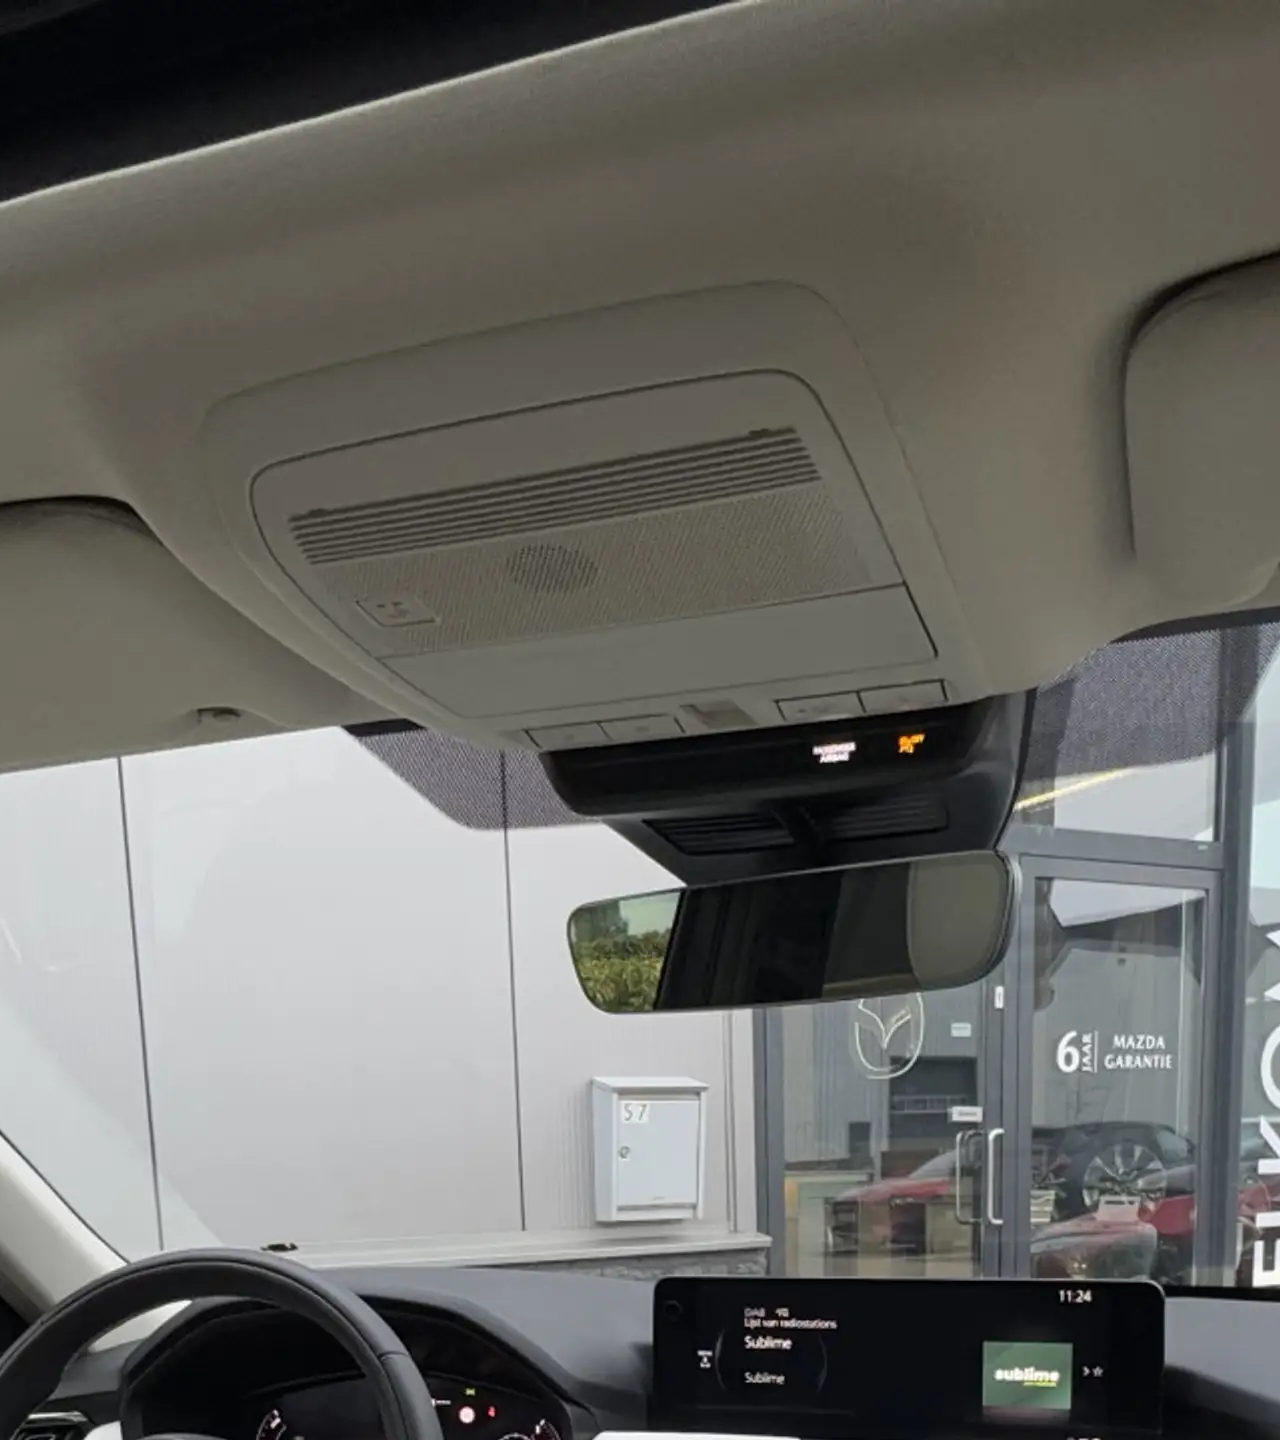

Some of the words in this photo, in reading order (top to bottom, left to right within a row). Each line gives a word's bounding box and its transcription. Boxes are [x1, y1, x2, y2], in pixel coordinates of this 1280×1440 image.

[1112, 1034, 1166, 1050] MAZDA
[1056, 1029, 1080, 1073] 6
[1081, 1032, 1093, 1072] JAAR
[1103, 1053, 1174, 1070] GARANTIE
[623, 1103, 648, 1121] 57
[1059, 1289, 1092, 1304] 11:24
[762, 1319, 779, 1328] van
[780, 1318, 838, 1330] radiostations
[744, 1335, 793, 1350] Sublime
[744, 1371, 786, 1385] Sublime
[994, 1366, 1061, 1382] sublime
